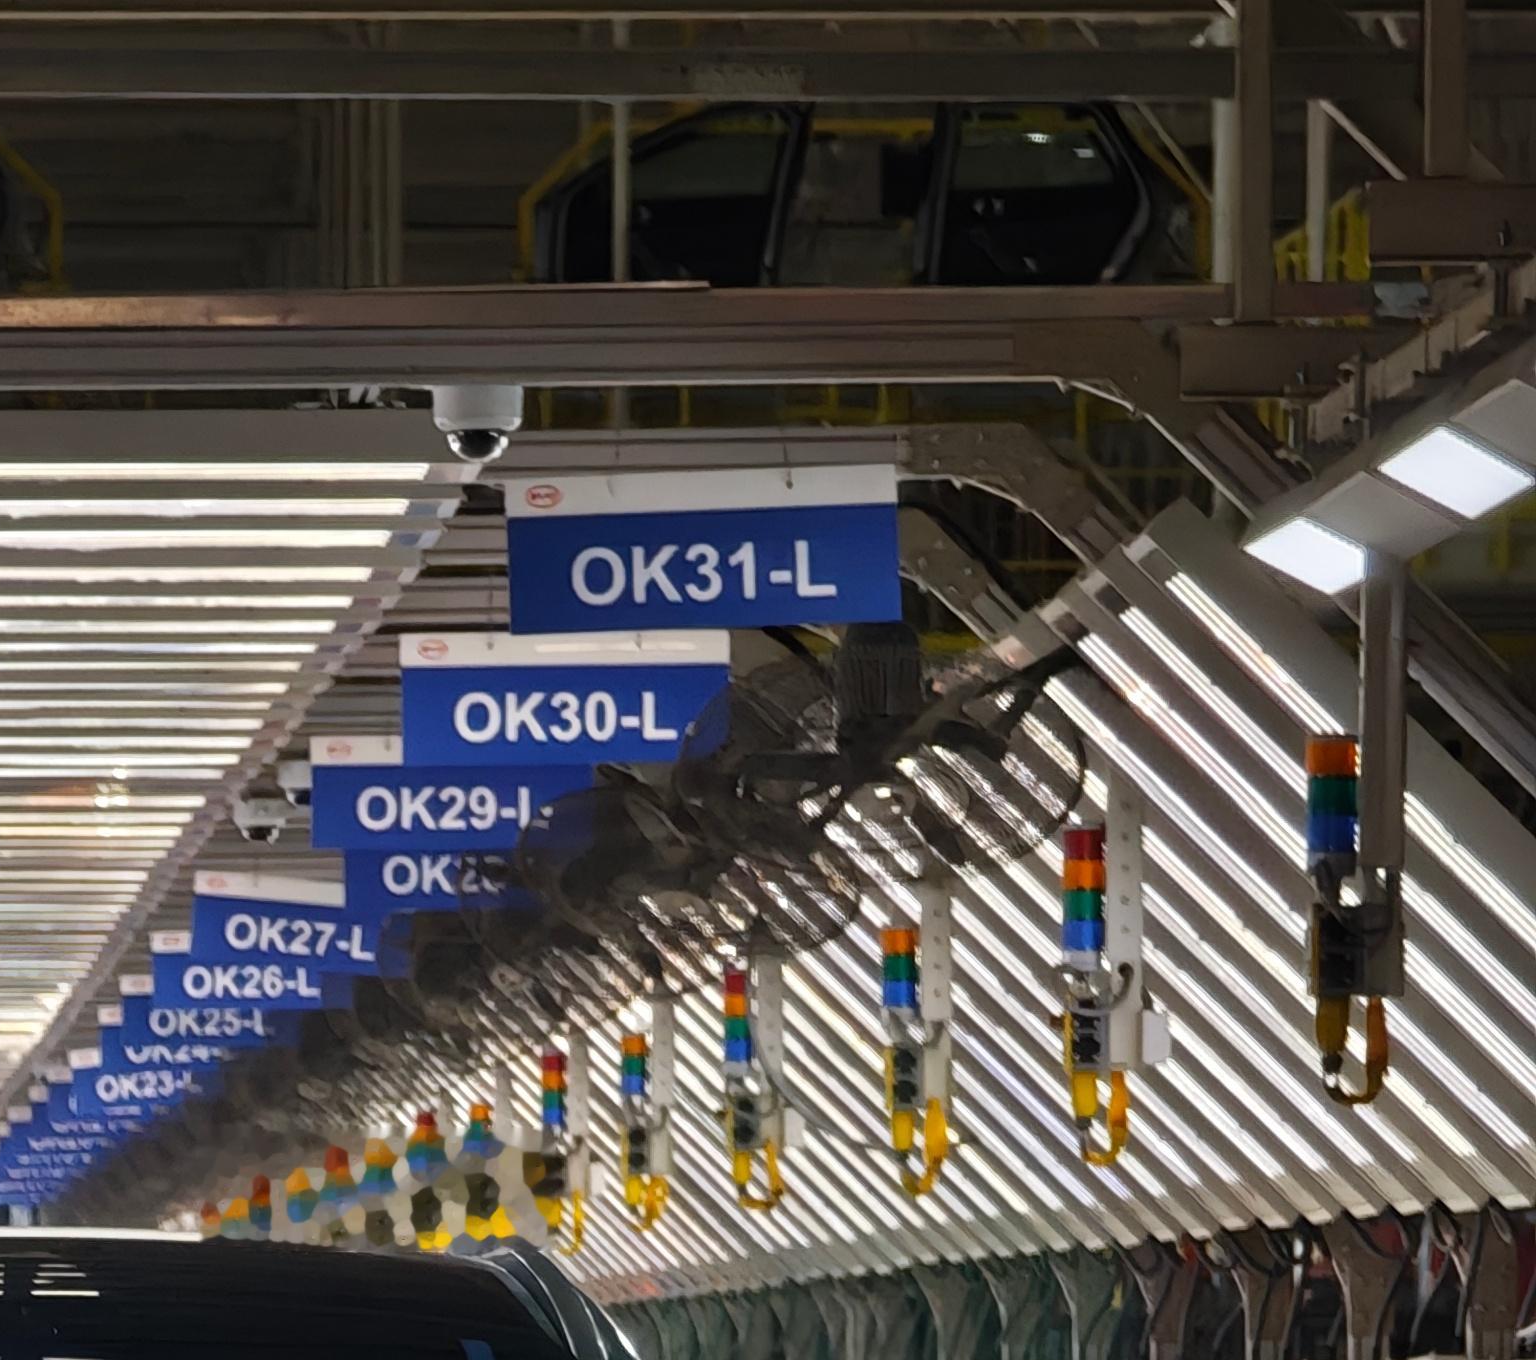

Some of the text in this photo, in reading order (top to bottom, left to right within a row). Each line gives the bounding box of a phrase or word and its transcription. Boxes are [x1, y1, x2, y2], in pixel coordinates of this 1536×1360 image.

[571, 539, 838, 606] OK31-L
[453, 691, 678, 743] OK30-L
[223, 912, 376, 962] OK27-L
[182, 964, 322, 1000] OK26-L
